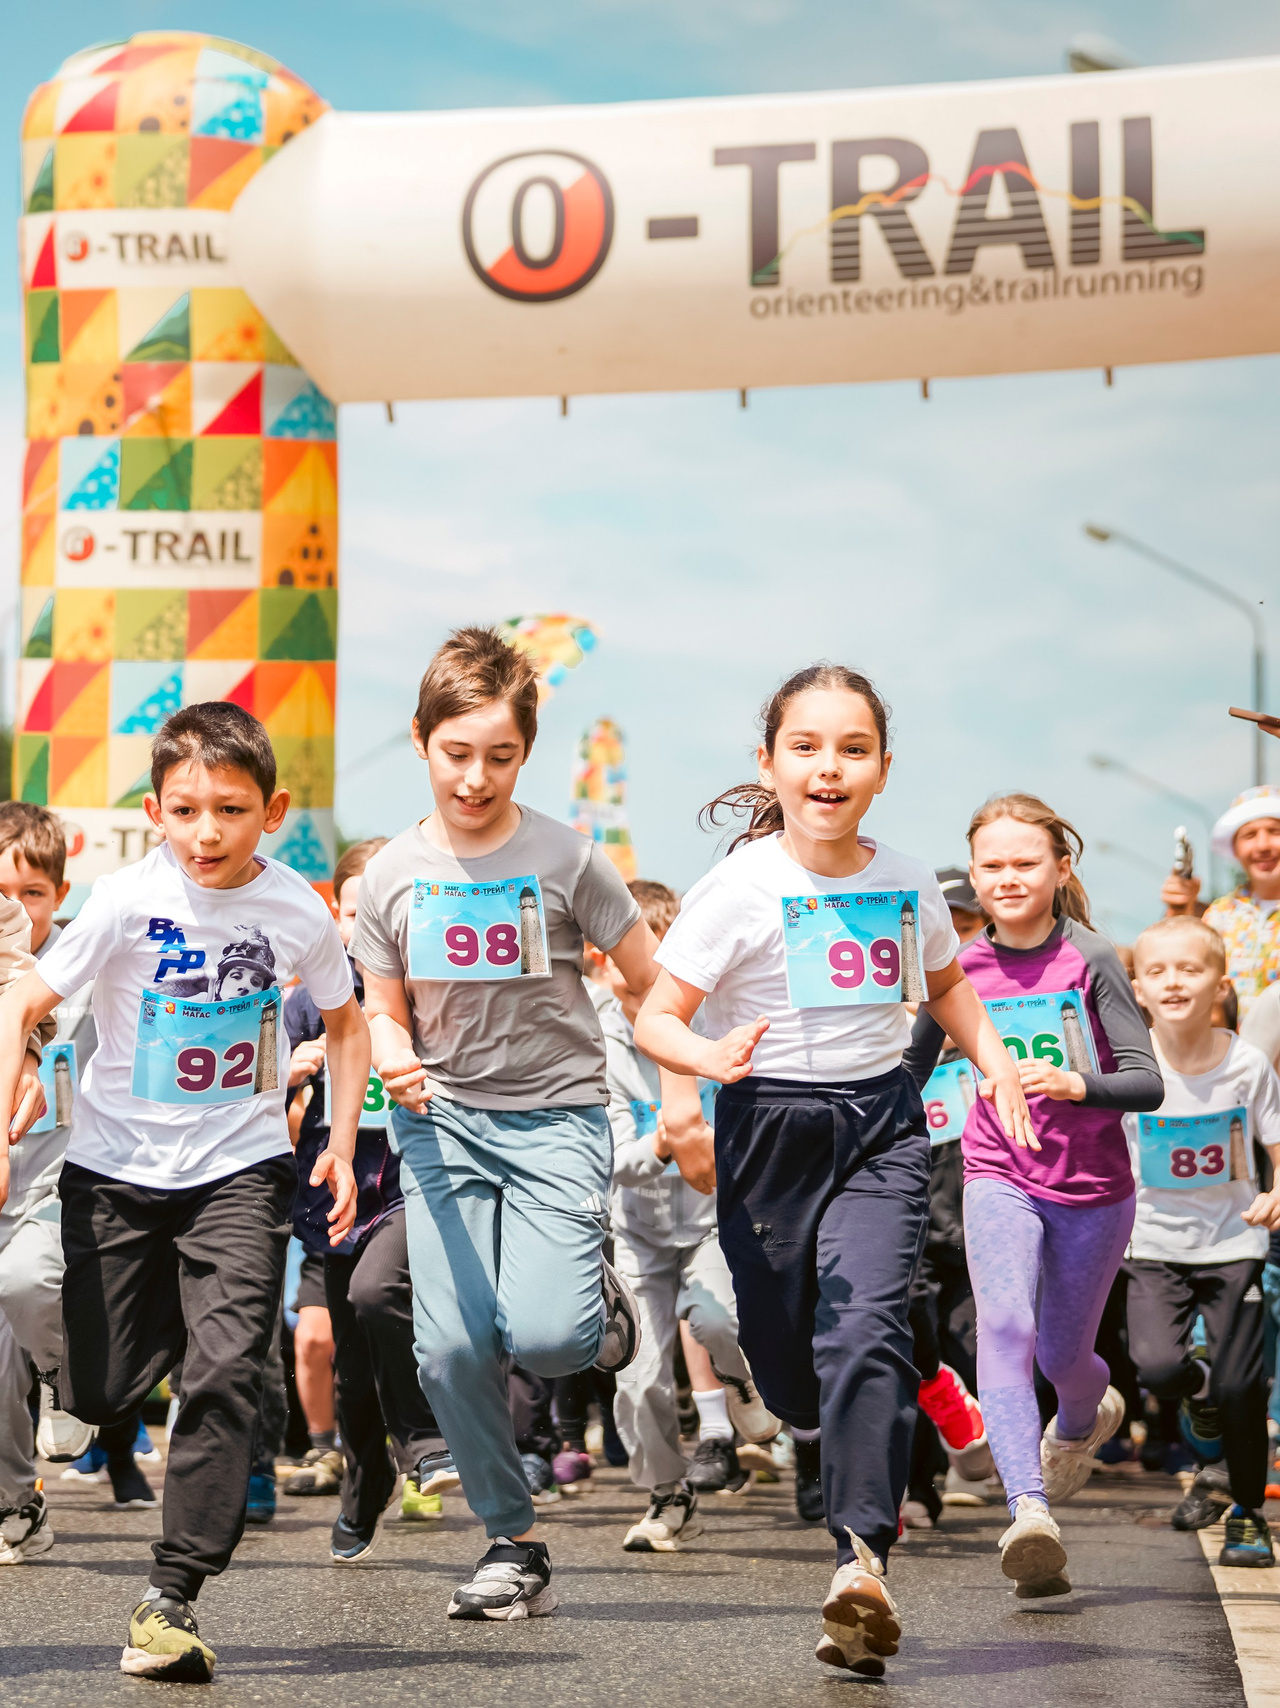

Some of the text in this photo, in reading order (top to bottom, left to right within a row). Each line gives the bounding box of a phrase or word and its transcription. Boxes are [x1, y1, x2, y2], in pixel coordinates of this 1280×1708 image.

[445, 923, 520, 967] 98
[828, 938, 900, 989] 99
[182, 1010, 211, 1018] МАГАС
[177, 1042, 255, 1092] 92
[1171, 1144, 1225, 1178] 83
